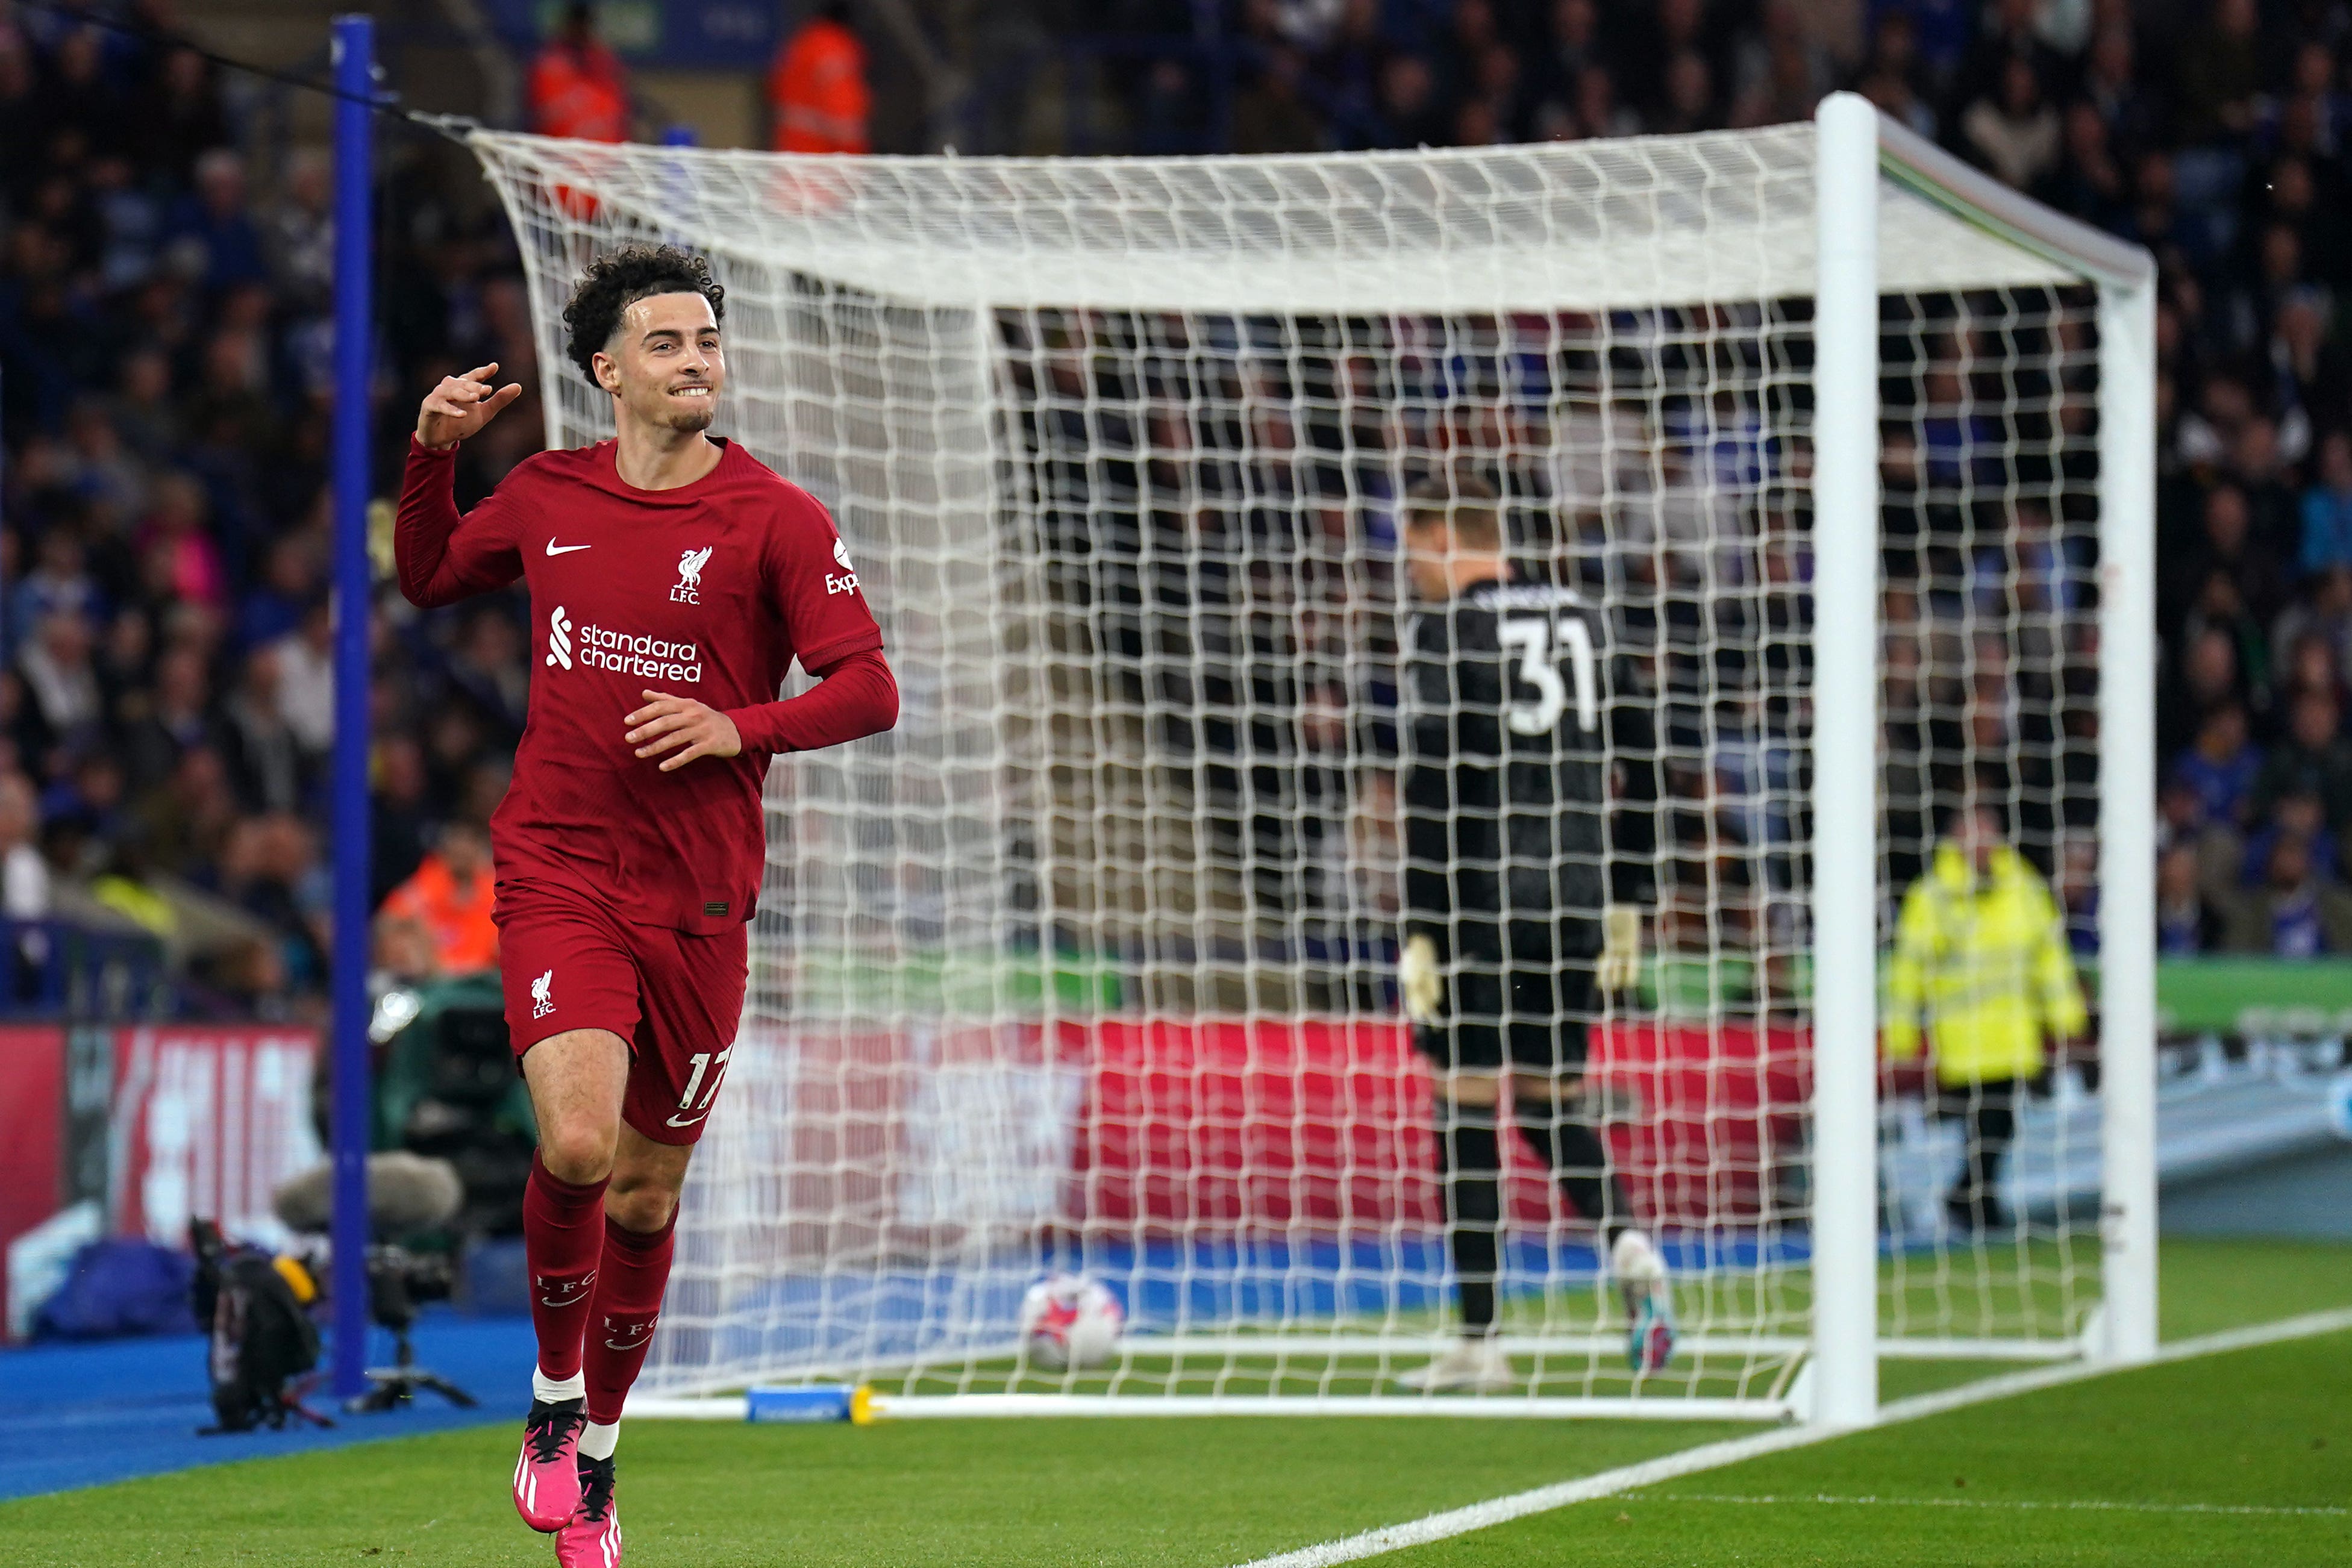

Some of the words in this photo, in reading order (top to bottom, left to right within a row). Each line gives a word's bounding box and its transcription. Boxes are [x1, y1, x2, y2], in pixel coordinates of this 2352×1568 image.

[825, 573, 860, 596] Exp
[580, 624, 696, 661] standard
[580, 646, 701, 682] chartered
[1497, 617, 1597, 736] 31
[678, 1041, 734, 1110] 17
